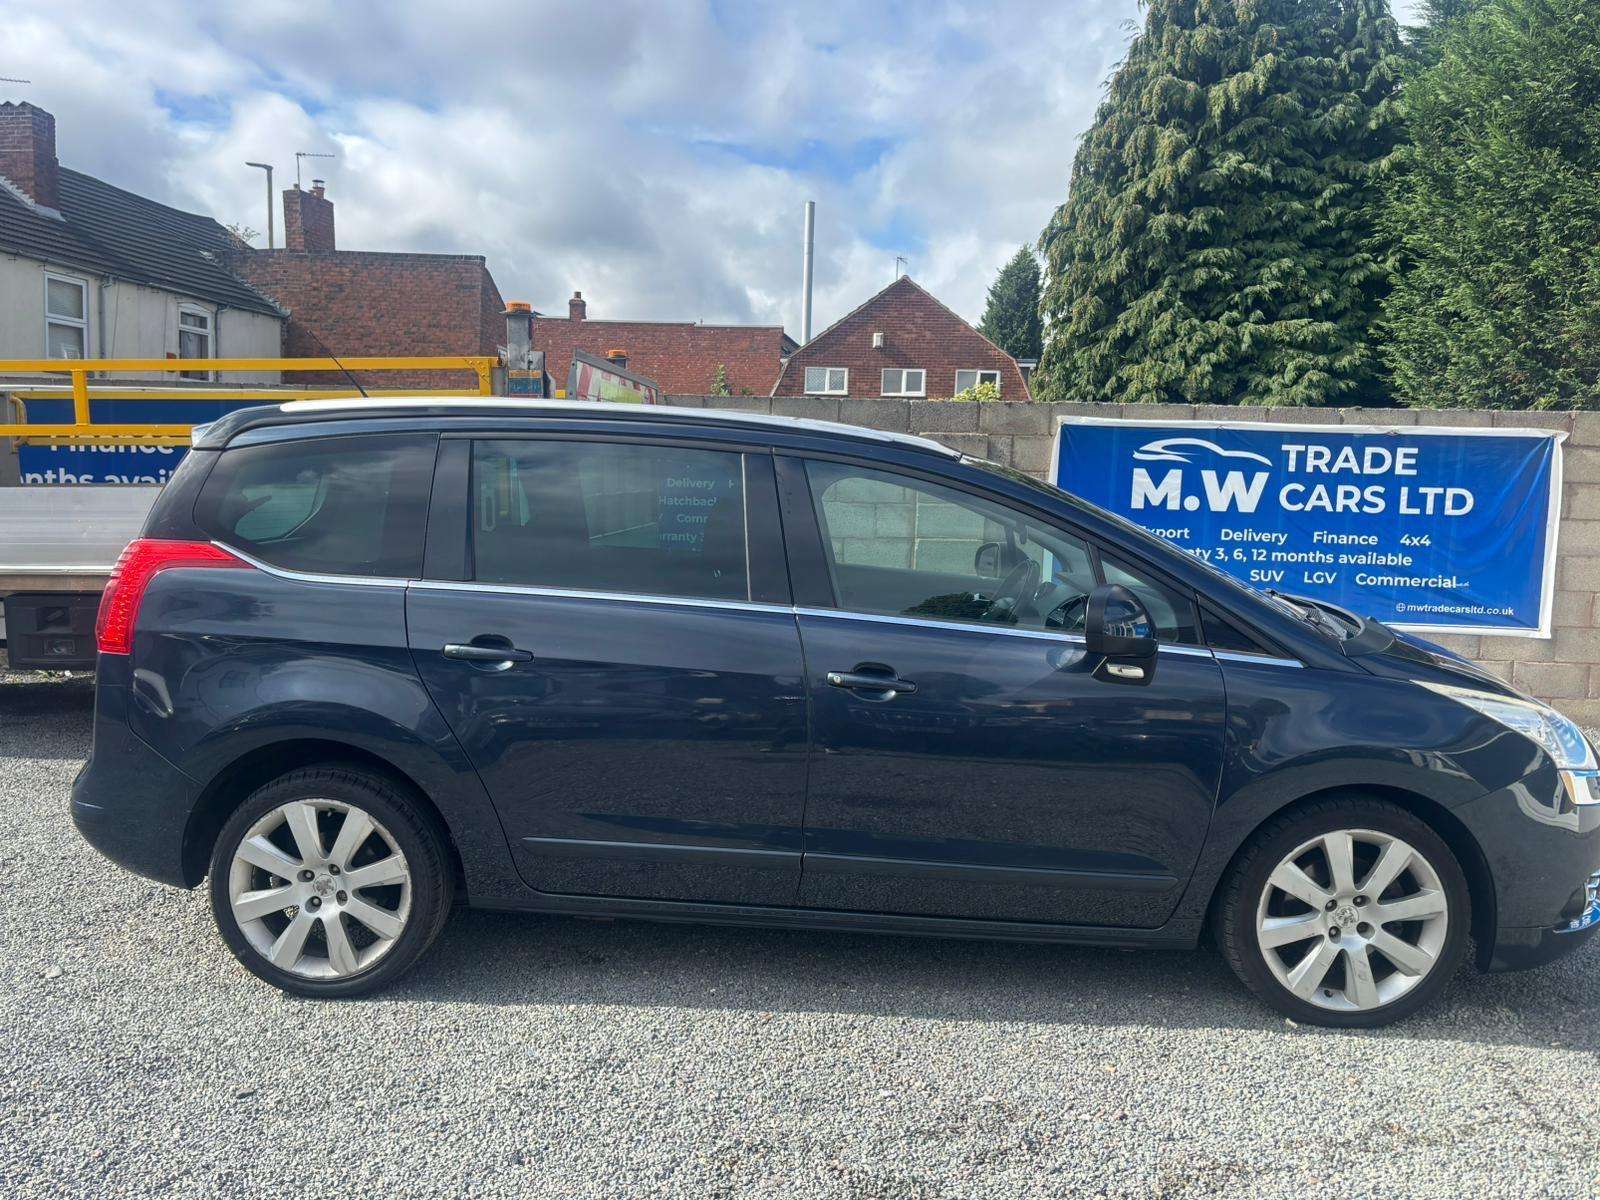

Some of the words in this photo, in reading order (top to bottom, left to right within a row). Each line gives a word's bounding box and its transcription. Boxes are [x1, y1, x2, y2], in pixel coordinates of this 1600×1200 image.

[1281, 444, 1419, 476] TRADE
[20, 468, 94, 484] nths
[104, 469, 173, 484] avai
[667, 477, 716, 490] Delivery
[1130, 467, 1270, 513] M.W
[1278, 482, 1386, 514] CARS
[1398, 486, 1475, 516] LTD
[1220, 528, 1288, 545] Delivery
[1312, 530, 1379, 546] Finance
[1399, 533, 1432, 547] 4x4
[1251, 549, 1267, 561] 12
[1271, 550, 1335, 563] months
[1338, 551, 1413, 567] available
[1249, 569, 1285, 582] SUV
[1303, 571, 1338, 584] LGV
[1355, 573, 1457, 589] Commercial
